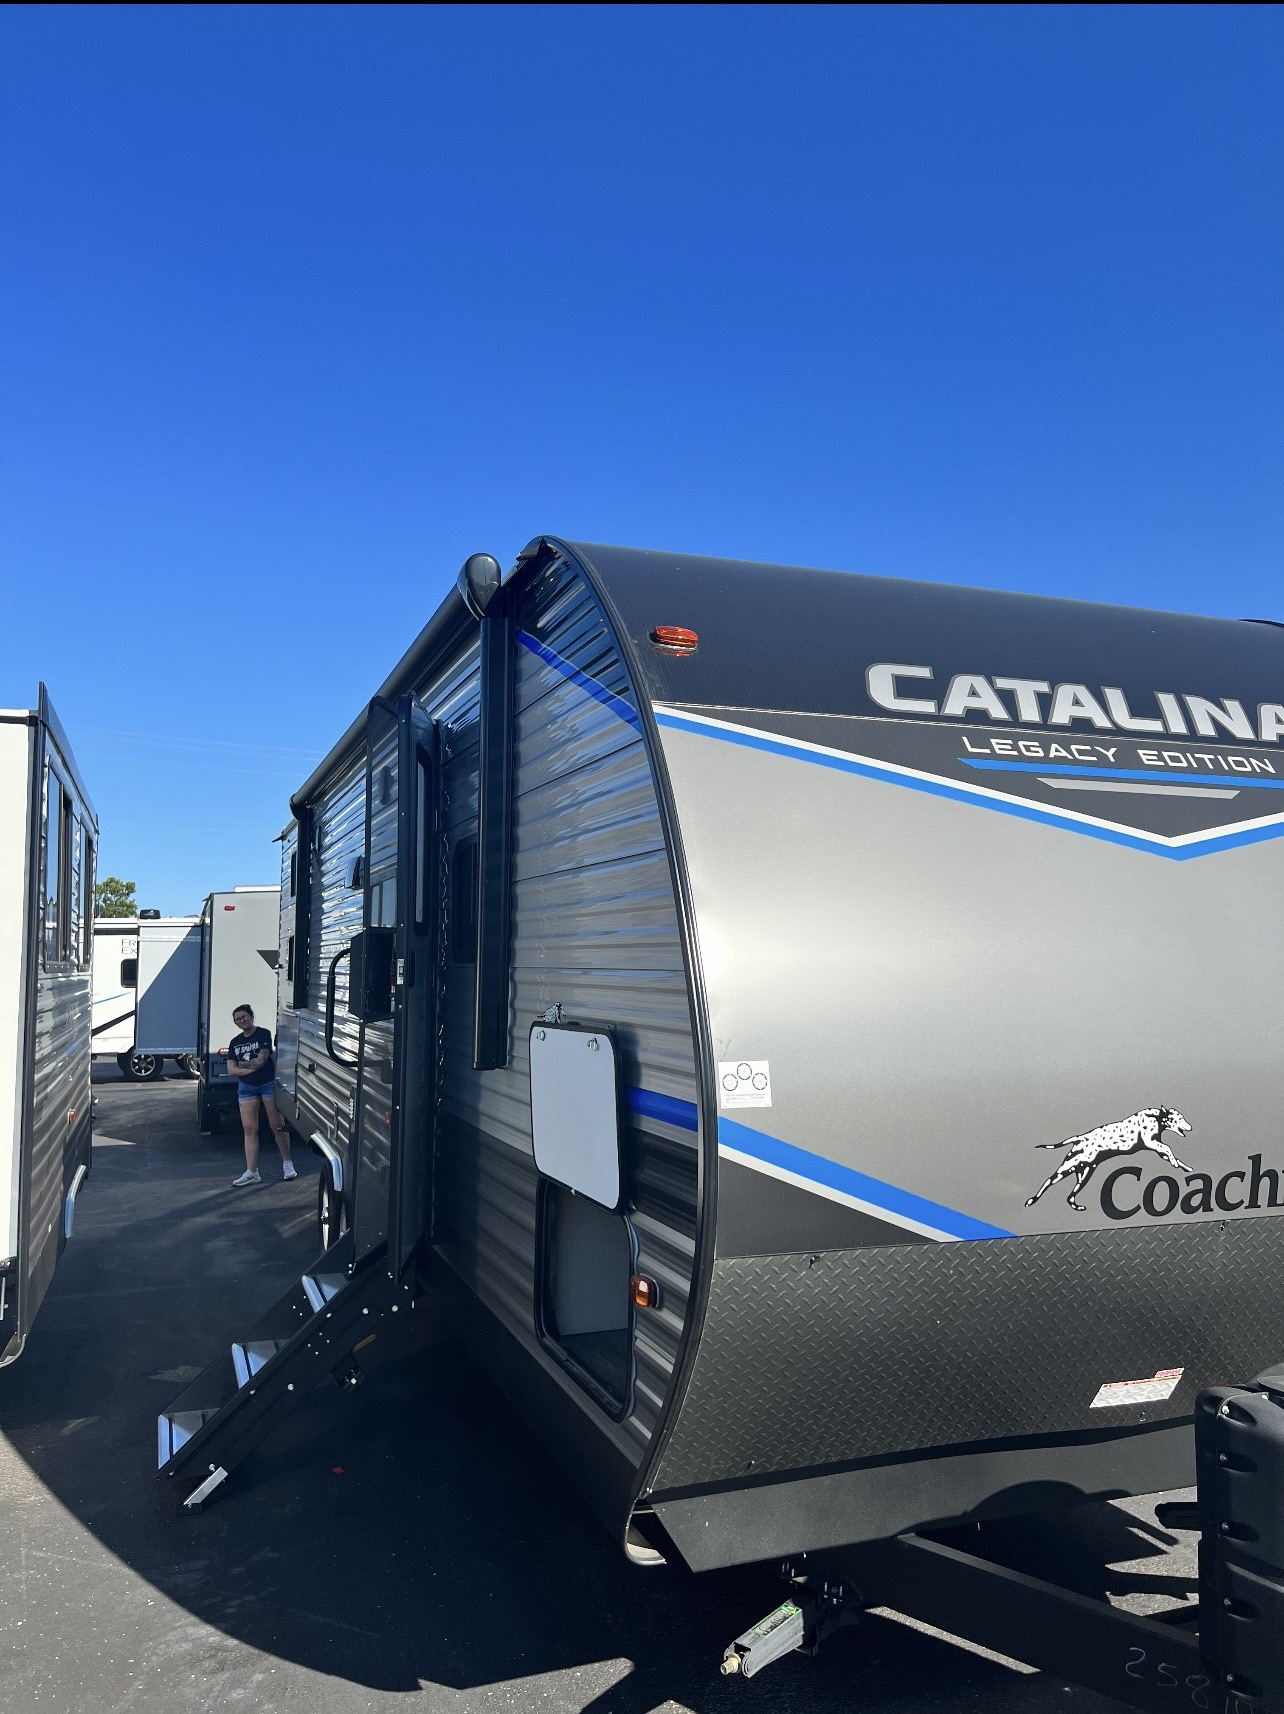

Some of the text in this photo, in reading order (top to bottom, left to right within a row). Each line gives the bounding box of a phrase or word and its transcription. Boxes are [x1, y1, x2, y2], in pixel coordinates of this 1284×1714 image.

[962, 736, 1277, 774] LEGACY EDITION
[1100, 1153, 1284, 1220] Coach
